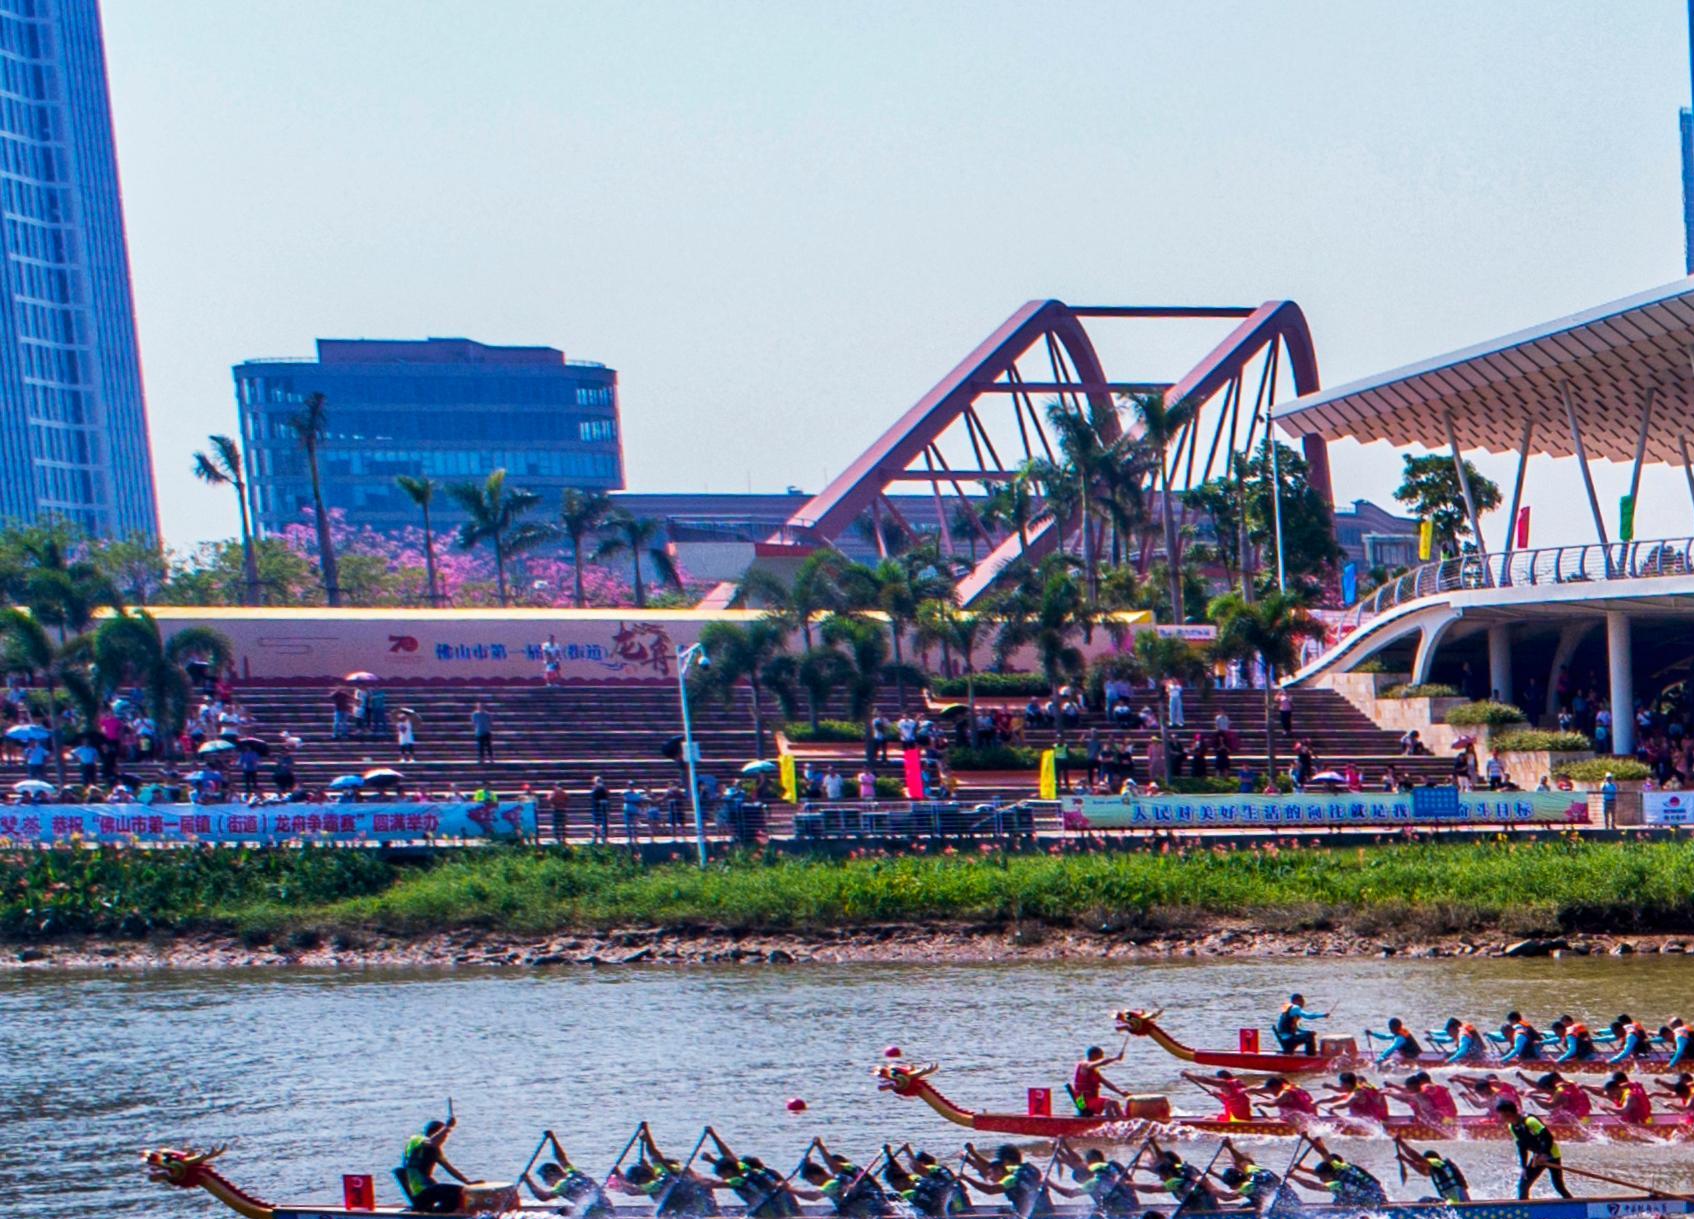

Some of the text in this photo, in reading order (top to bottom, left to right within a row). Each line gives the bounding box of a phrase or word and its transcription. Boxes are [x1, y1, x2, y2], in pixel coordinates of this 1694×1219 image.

[1133, 803, 1533, 823] 人民对美好生活的向往就是我奋斗目标
